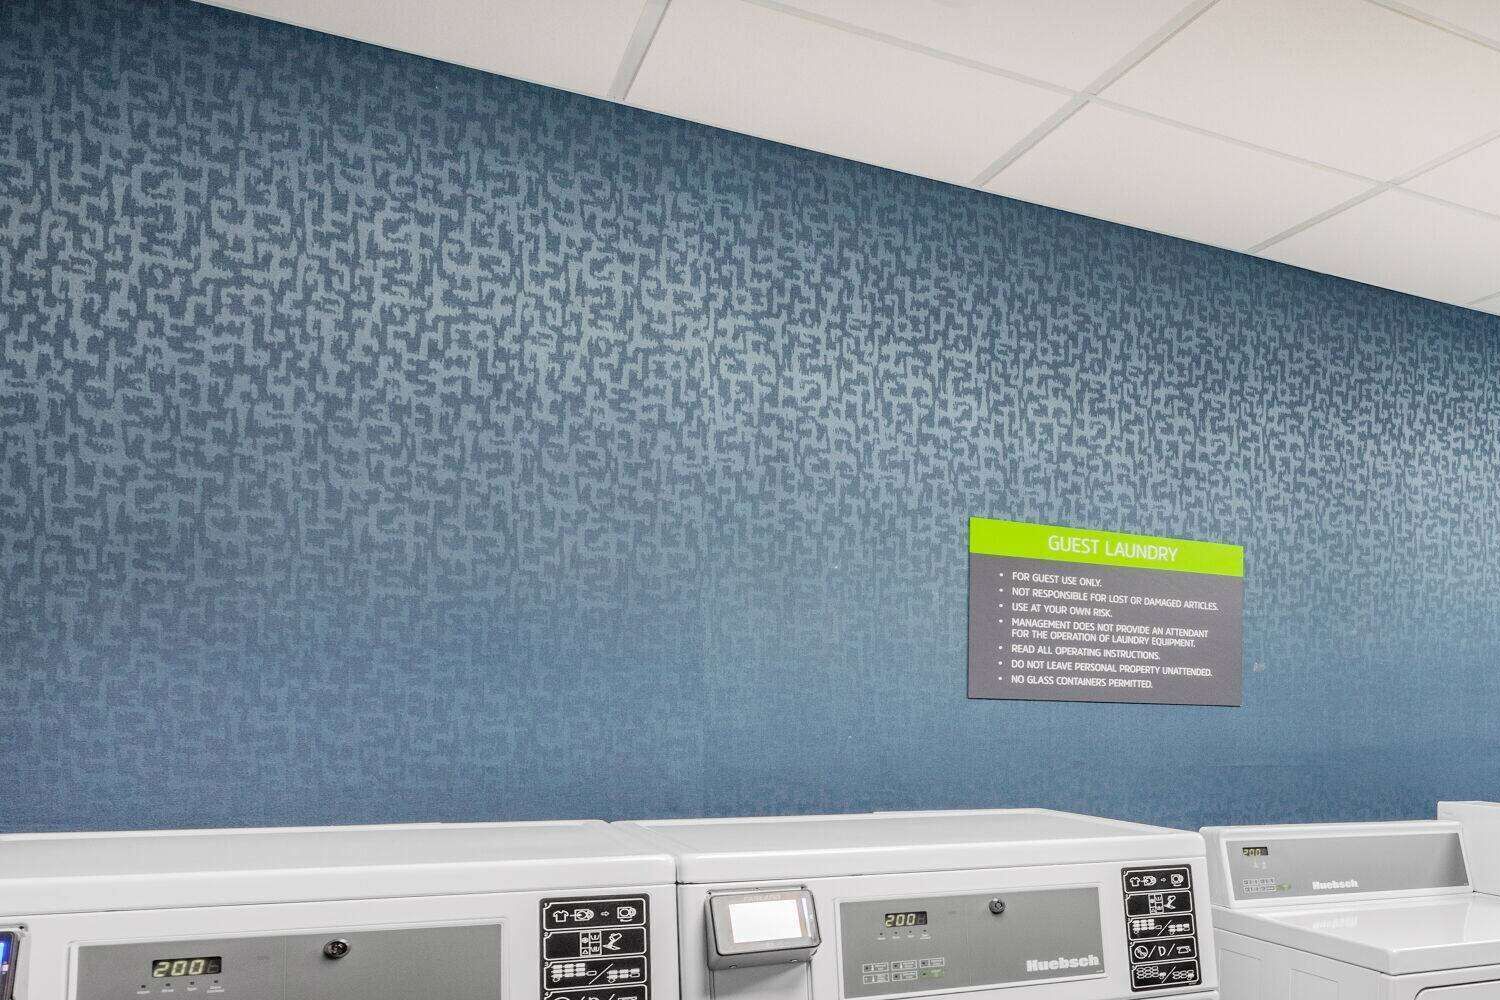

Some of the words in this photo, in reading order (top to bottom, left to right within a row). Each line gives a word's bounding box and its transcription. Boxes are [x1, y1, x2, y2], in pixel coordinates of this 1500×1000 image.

[1048, 535, 1100, 554] GUEST
[1105, 540, 1178, 561] LAUNDRY
[1012, 571, 1030, 581] FOR
[1032, 573, 1059, 583] GUEST
[1061, 576, 1077, 585] USE
[1079, 577, 1102, 587] ONLY.
[1012, 587, 1030, 596] NOT
[1032, 588, 1088, 601] RESPONSIBLE
[1090, 593, 1106, 602] FOR
[1108, 594, 1128, 604] LOST
[1130, 596, 1142, 605] OR
[1143, 597, 1182, 608] DAMAGED
[1183, 600, 1219, 611] ARTICLES.
[1012, 602, 1028, 612] USE
[1030, 604, 1041, 612] AT
[1043, 605, 1067, 614] YOUR
[1069, 606, 1091, 616] OWN
[1093, 608, 1112, 618] RISK.
[1011, 618, 1071, 629] MANAGEMENT
[1073, 621, 1094, 631] DOES
[1097, 623, 1114, 632] NOT
[1115, 624, 1150, 634] PROVIDE
[1151, 627, 1163, 635] AN
[1165, 627, 1208, 638] ATTENDANT
[1011, 628, 1029, 638] FOR
[1032, 630, 1047, 639] THE
[1050, 631, 1096, 642] OPERATION
[1098, 634, 1110, 643] OF
[1112, 635, 1149, 645] LAUNDRY
[1151, 637, 1196, 648] EQUIPMENT.
[1011, 644, 1035, 654] READ
[1037, 645, 1053, 655] ALL
[1055, 646, 1101, 657] OPERATING
[1103, 649, 1160, 660] INSTRUCTIONS.
[1011, 660, 1024, 668] DO
[1026, 660, 1044, 669] NOT
[1046, 661, 1072, 670] LEAVE
[1074, 662, 1117, 673] PERSONAL
[1119, 664, 1160, 675] PROPERTY
[1162, 667, 1213, 677] UNATTENDED.
[1011, 675, 1024, 684] NO
[1027, 675, 1054, 685] GLASS
[1056, 676, 1106, 687] CONTAINERS
[1108, 679, 1153, 689] PERMITTED.
[1312, 879, 1359, 890] Huebsch
[885, 913, 916, 928] 200
[153, 959, 205, 978] 200
[1026, 954, 1100, 972] Huebsch
